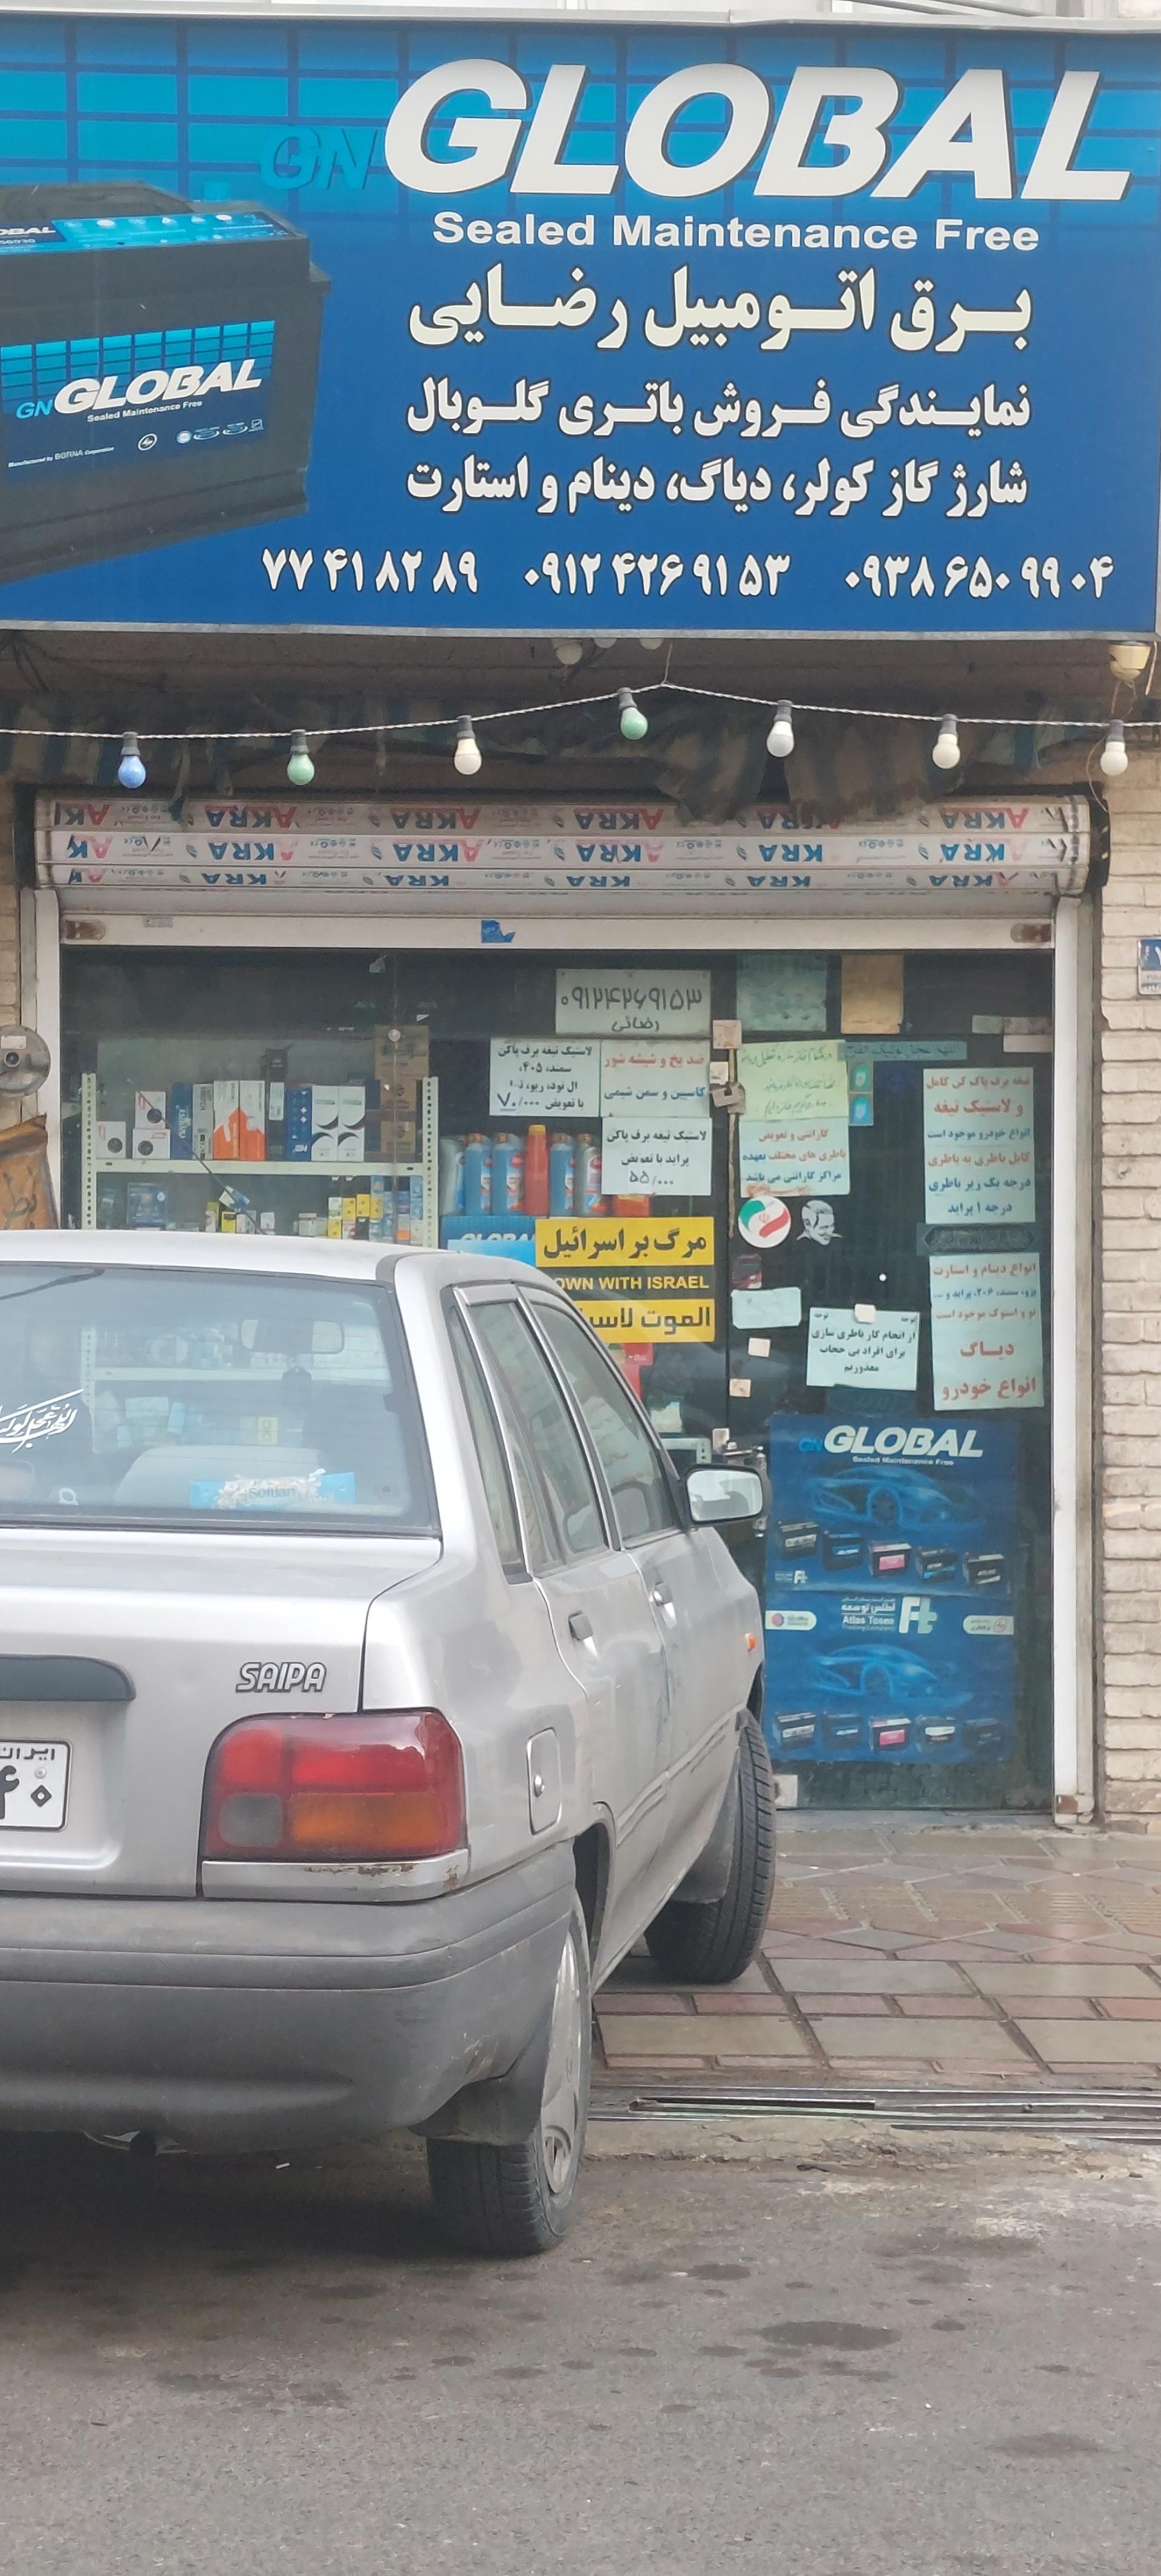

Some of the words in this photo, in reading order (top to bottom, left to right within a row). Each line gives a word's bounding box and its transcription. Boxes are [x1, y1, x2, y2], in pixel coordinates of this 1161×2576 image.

[384, 58, 1131, 200] GLOBAL
[433, 212, 595, 245] Sealed
[613, 215, 918, 249] Maintenance
[935, 219, 1039, 251] Free
[409, 262, 628, 349] رضایی
[645, 265, 876, 351] اتومبیل
[891, 278, 1032, 352] برق
[16, 398, 53, 419] GN
[54, 359, 262, 414] GLOBAL
[407, 376, 550, 434] گلوبال
[558, 380, 684, 436] باتری
[694, 379, 831, 437] فروش
[87, 411, 120, 423] Sealed
[123, 403, 180, 418] Maintenance
[183, 400, 203, 409] Free
[841, 384, 1030, 438] نمایندگی
[406, 455, 529, 512] استارت
[537, 471, 559, 513] و
[569, 457, 655, 514] دینام
[882, 458, 938, 516] گاز
[946, 459, 1029, 516] شارژ
[390, 807, 482, 830] AKRA
[574, 807, 663, 831] AKRA
[940, 806, 1029, 830] AKRA
[392, 838, 483, 863] AKRA
[561, 986, 702, 1011] ۰۹۱۲۴۲۶۹۱۵۳
[544, 1225, 625, 1259] اسرائیل
[628, 1232, 649, 1259] بر
[653, 1227, 707, 1258] مرگ
[554, 1277, 594, 1290] OWN
[598, 1276, 643, 1290] WITH
[646, 1276, 710, 1290] ISRAEL
[941, 1377, 992, 1400] خودرو
[824, 1425, 984, 1458] GLOBAL
[842, 1615, 866, 1625] Atlas
[236, 1661, 327, 1693] SAIPA
